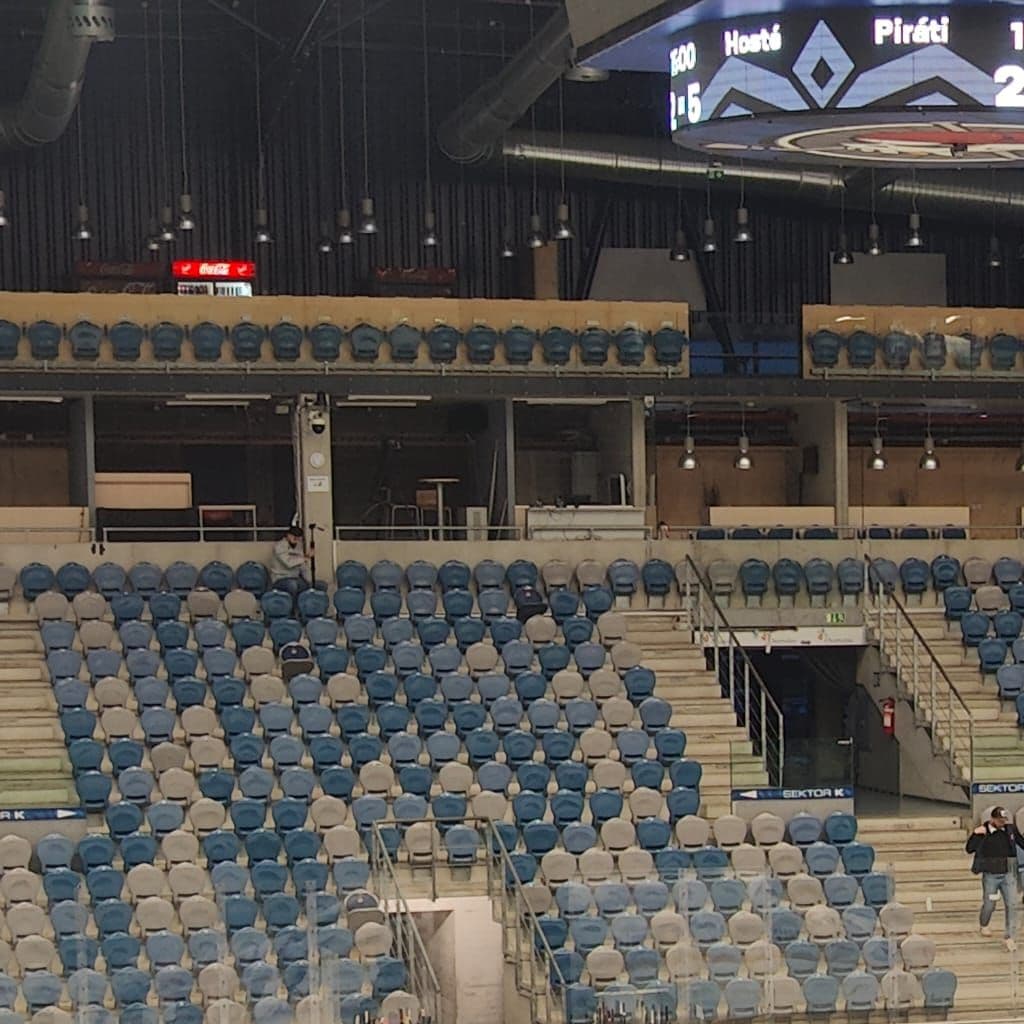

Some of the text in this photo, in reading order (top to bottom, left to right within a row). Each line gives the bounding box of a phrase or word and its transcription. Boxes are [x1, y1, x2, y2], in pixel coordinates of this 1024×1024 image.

[874, 16, 949, 44] Piráti
[978, 783, 1024, 792] SEKTOR
[783, 788, 844, 798] SEKTOR K
